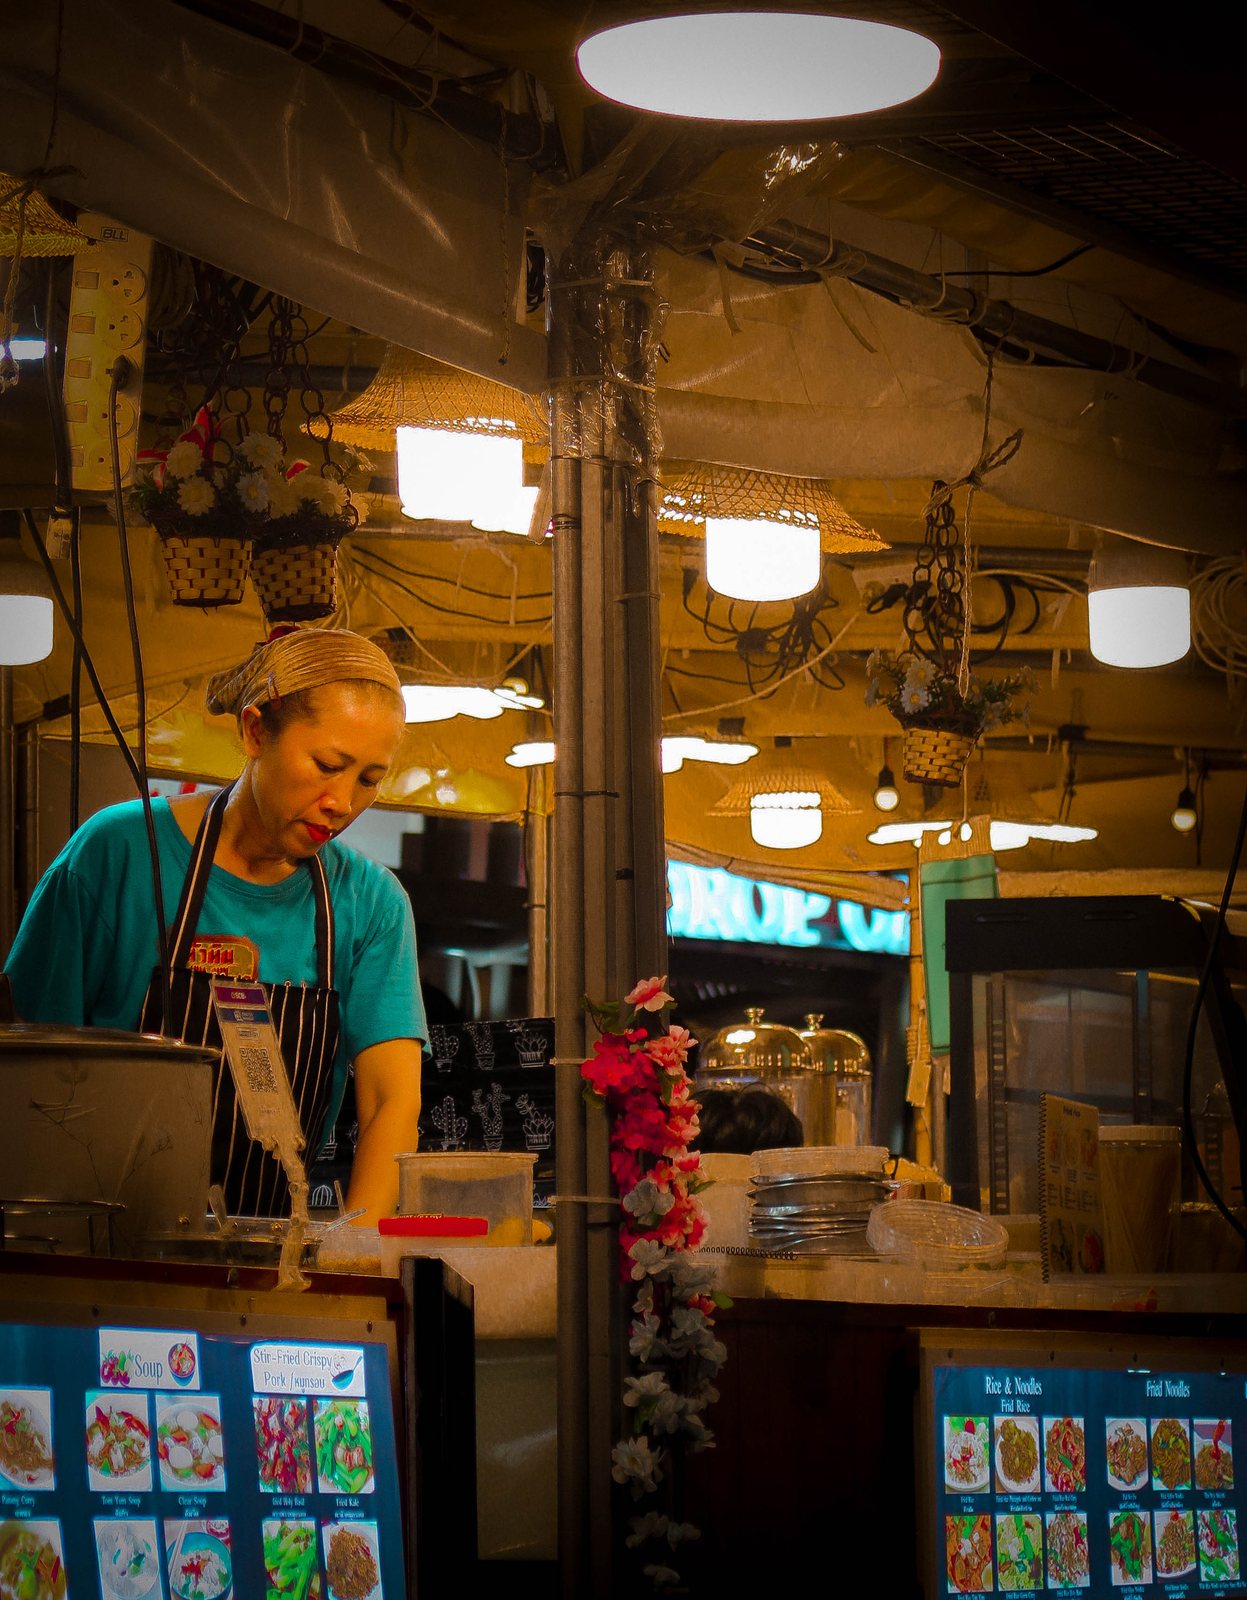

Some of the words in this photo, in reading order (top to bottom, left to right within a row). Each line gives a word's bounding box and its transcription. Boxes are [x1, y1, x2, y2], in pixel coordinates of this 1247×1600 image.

[253, 1348, 300, 1365] Stir-Fried
[303, 1350, 332, 1370] Crispy
[135, 1354, 163, 1385] Soup
[264, 1371, 286, 1387] Pork
[985, 1376, 1002, 1395] Rice
[1004, 1376, 1013, 1395] &
[1014, 1376, 1043, 1396] Noodles
[1165, 1380, 1190, 1398] Noodles
[1016, 1399, 1031, 1413] Rice
